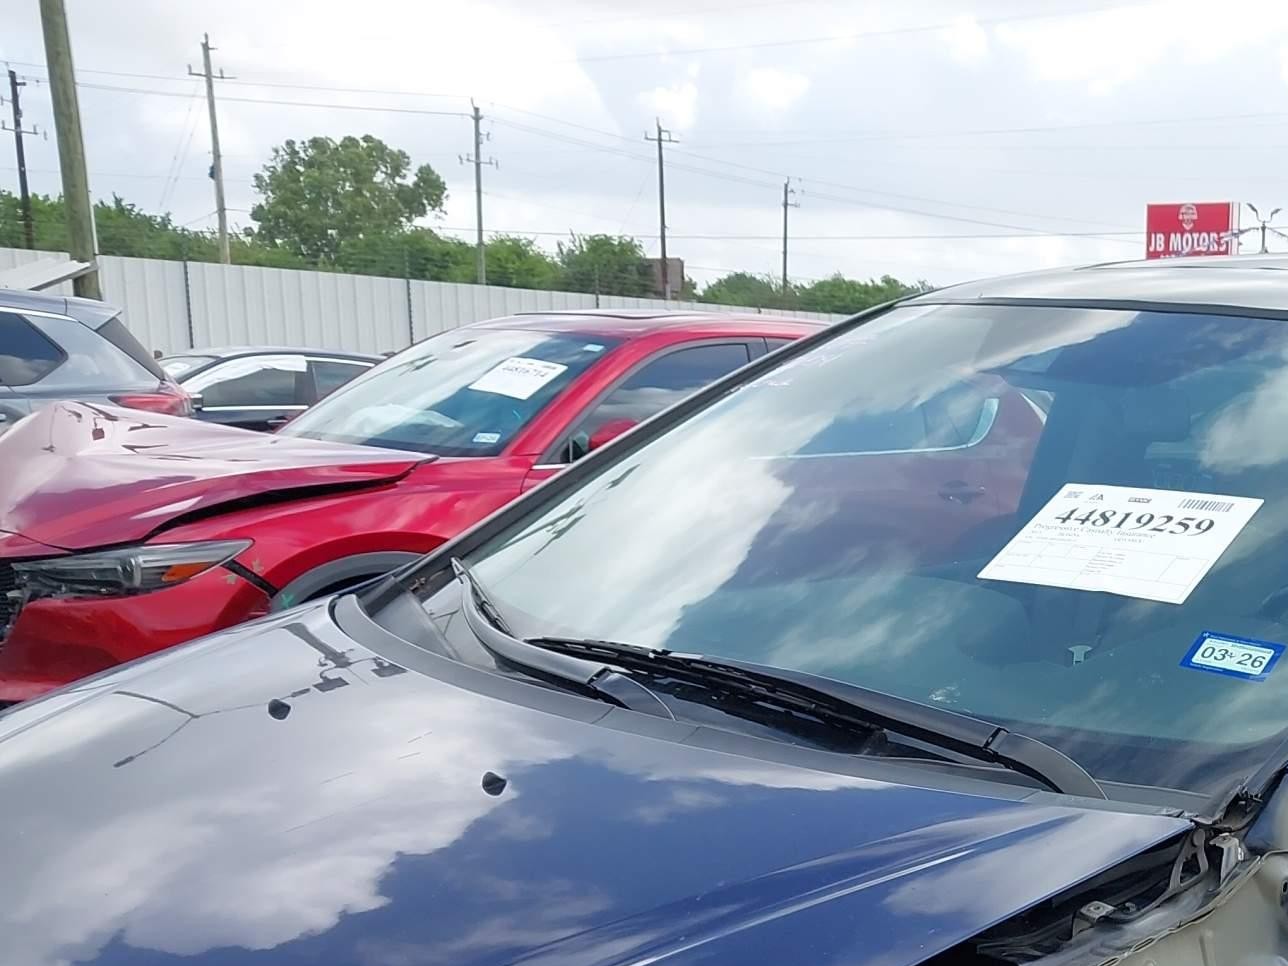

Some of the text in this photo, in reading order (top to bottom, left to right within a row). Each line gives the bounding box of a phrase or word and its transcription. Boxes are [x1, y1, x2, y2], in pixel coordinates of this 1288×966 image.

[1149, 231, 1227, 253] JB MOTORS
[1054, 506, 1215, 537] 44819259
[1201, 646, 1229, 661] 03
[1236, 653, 1266, 668] 26
